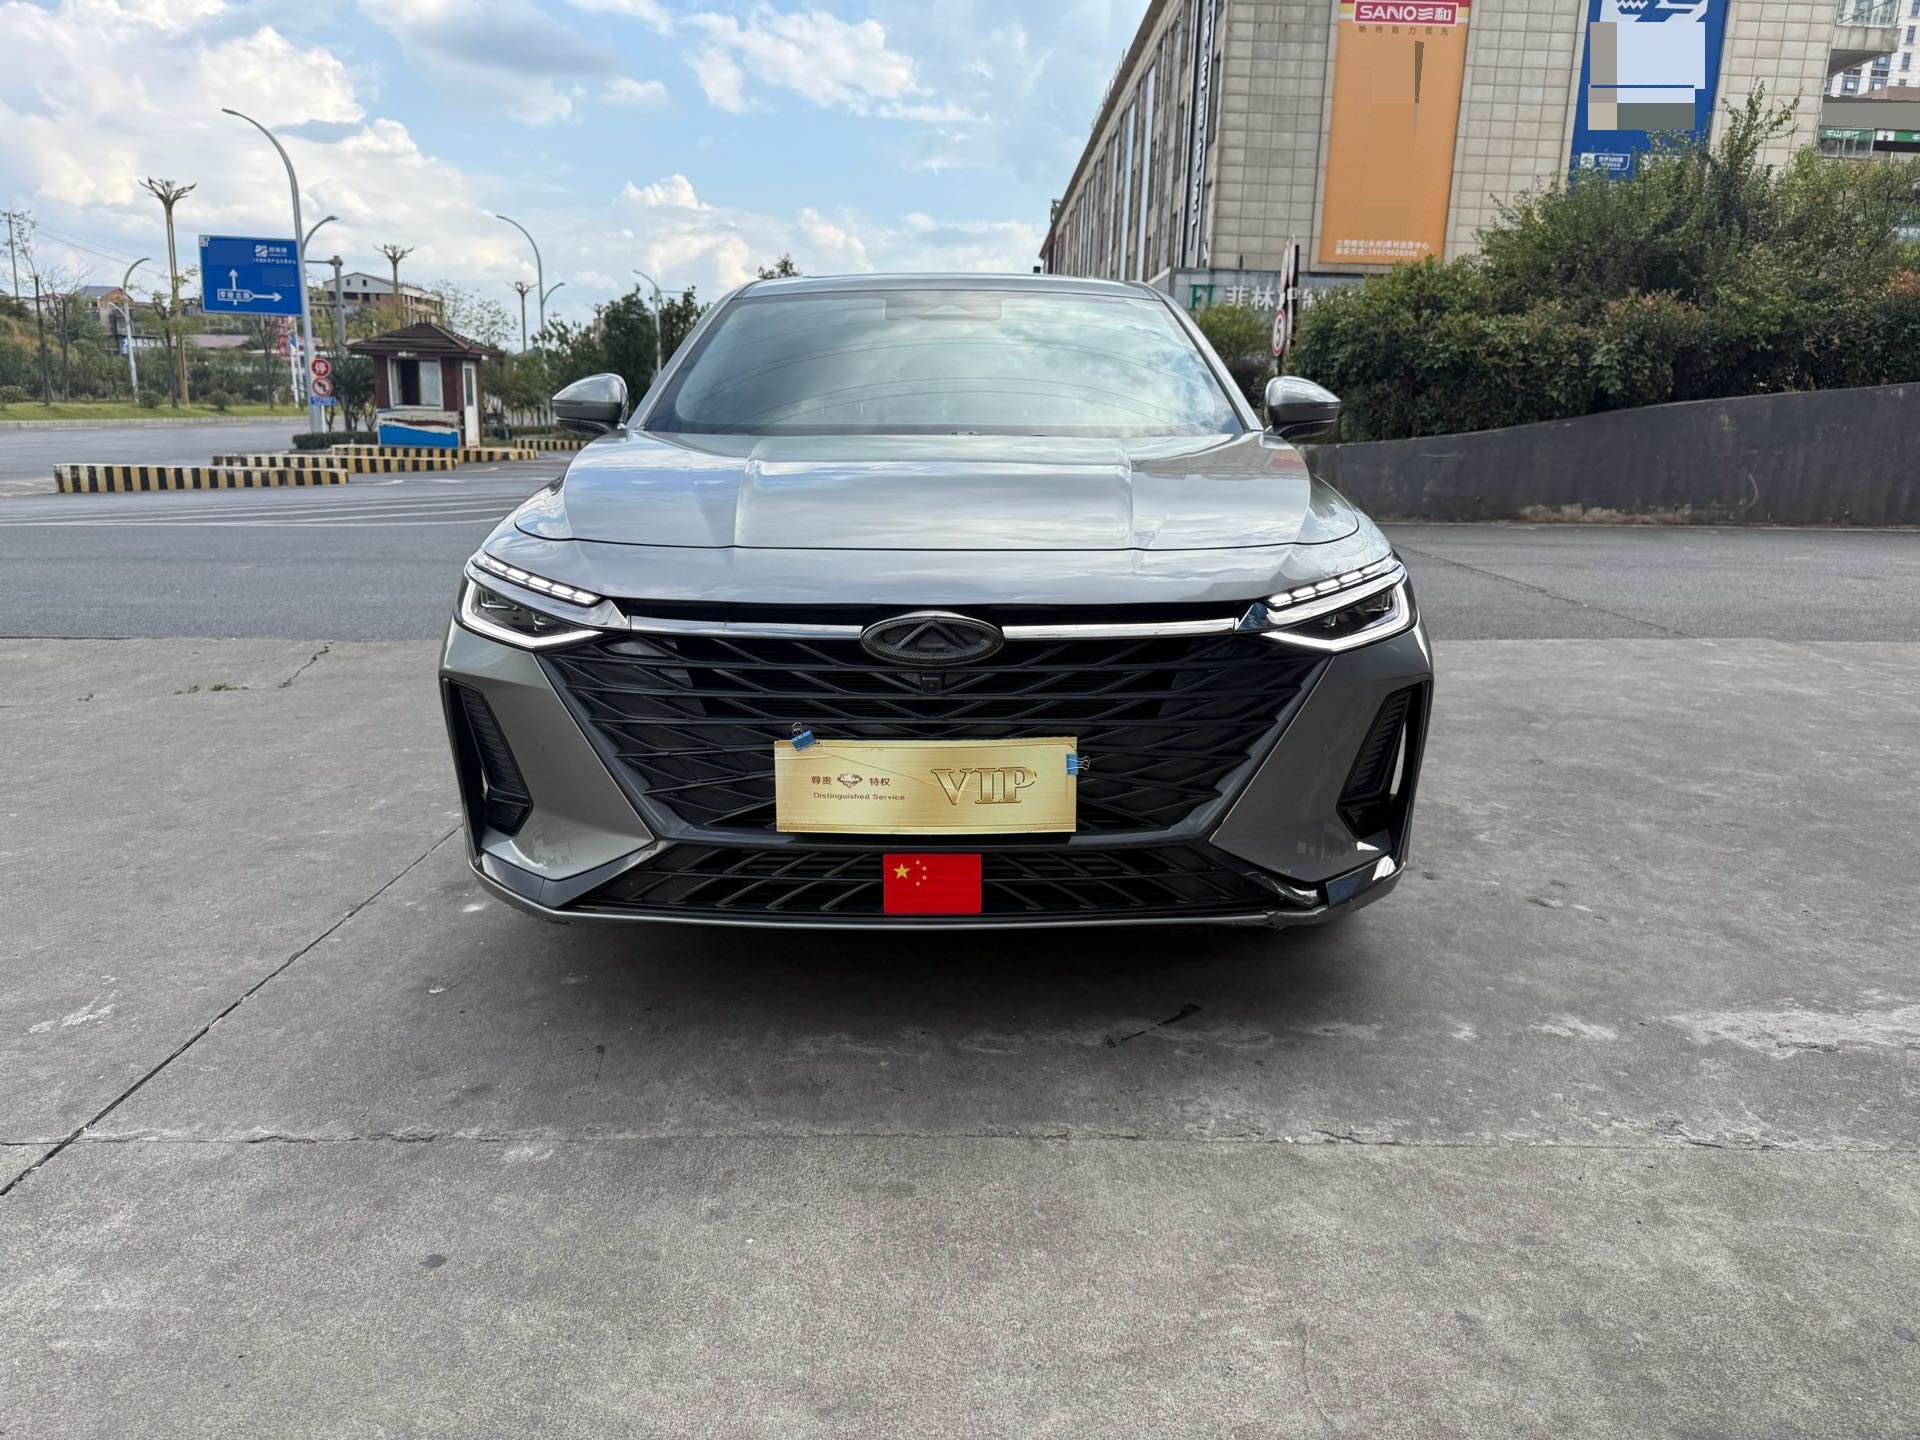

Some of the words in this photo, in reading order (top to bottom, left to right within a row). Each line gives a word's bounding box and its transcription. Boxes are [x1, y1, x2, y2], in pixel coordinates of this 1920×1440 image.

[811, 775, 832, 786] 尊贵
[869, 777, 890, 787] 特权
[930, 766, 1038, 806] VIP
[813, 791, 870, 801] Distinguished
[872, 793, 905, 801] Service
